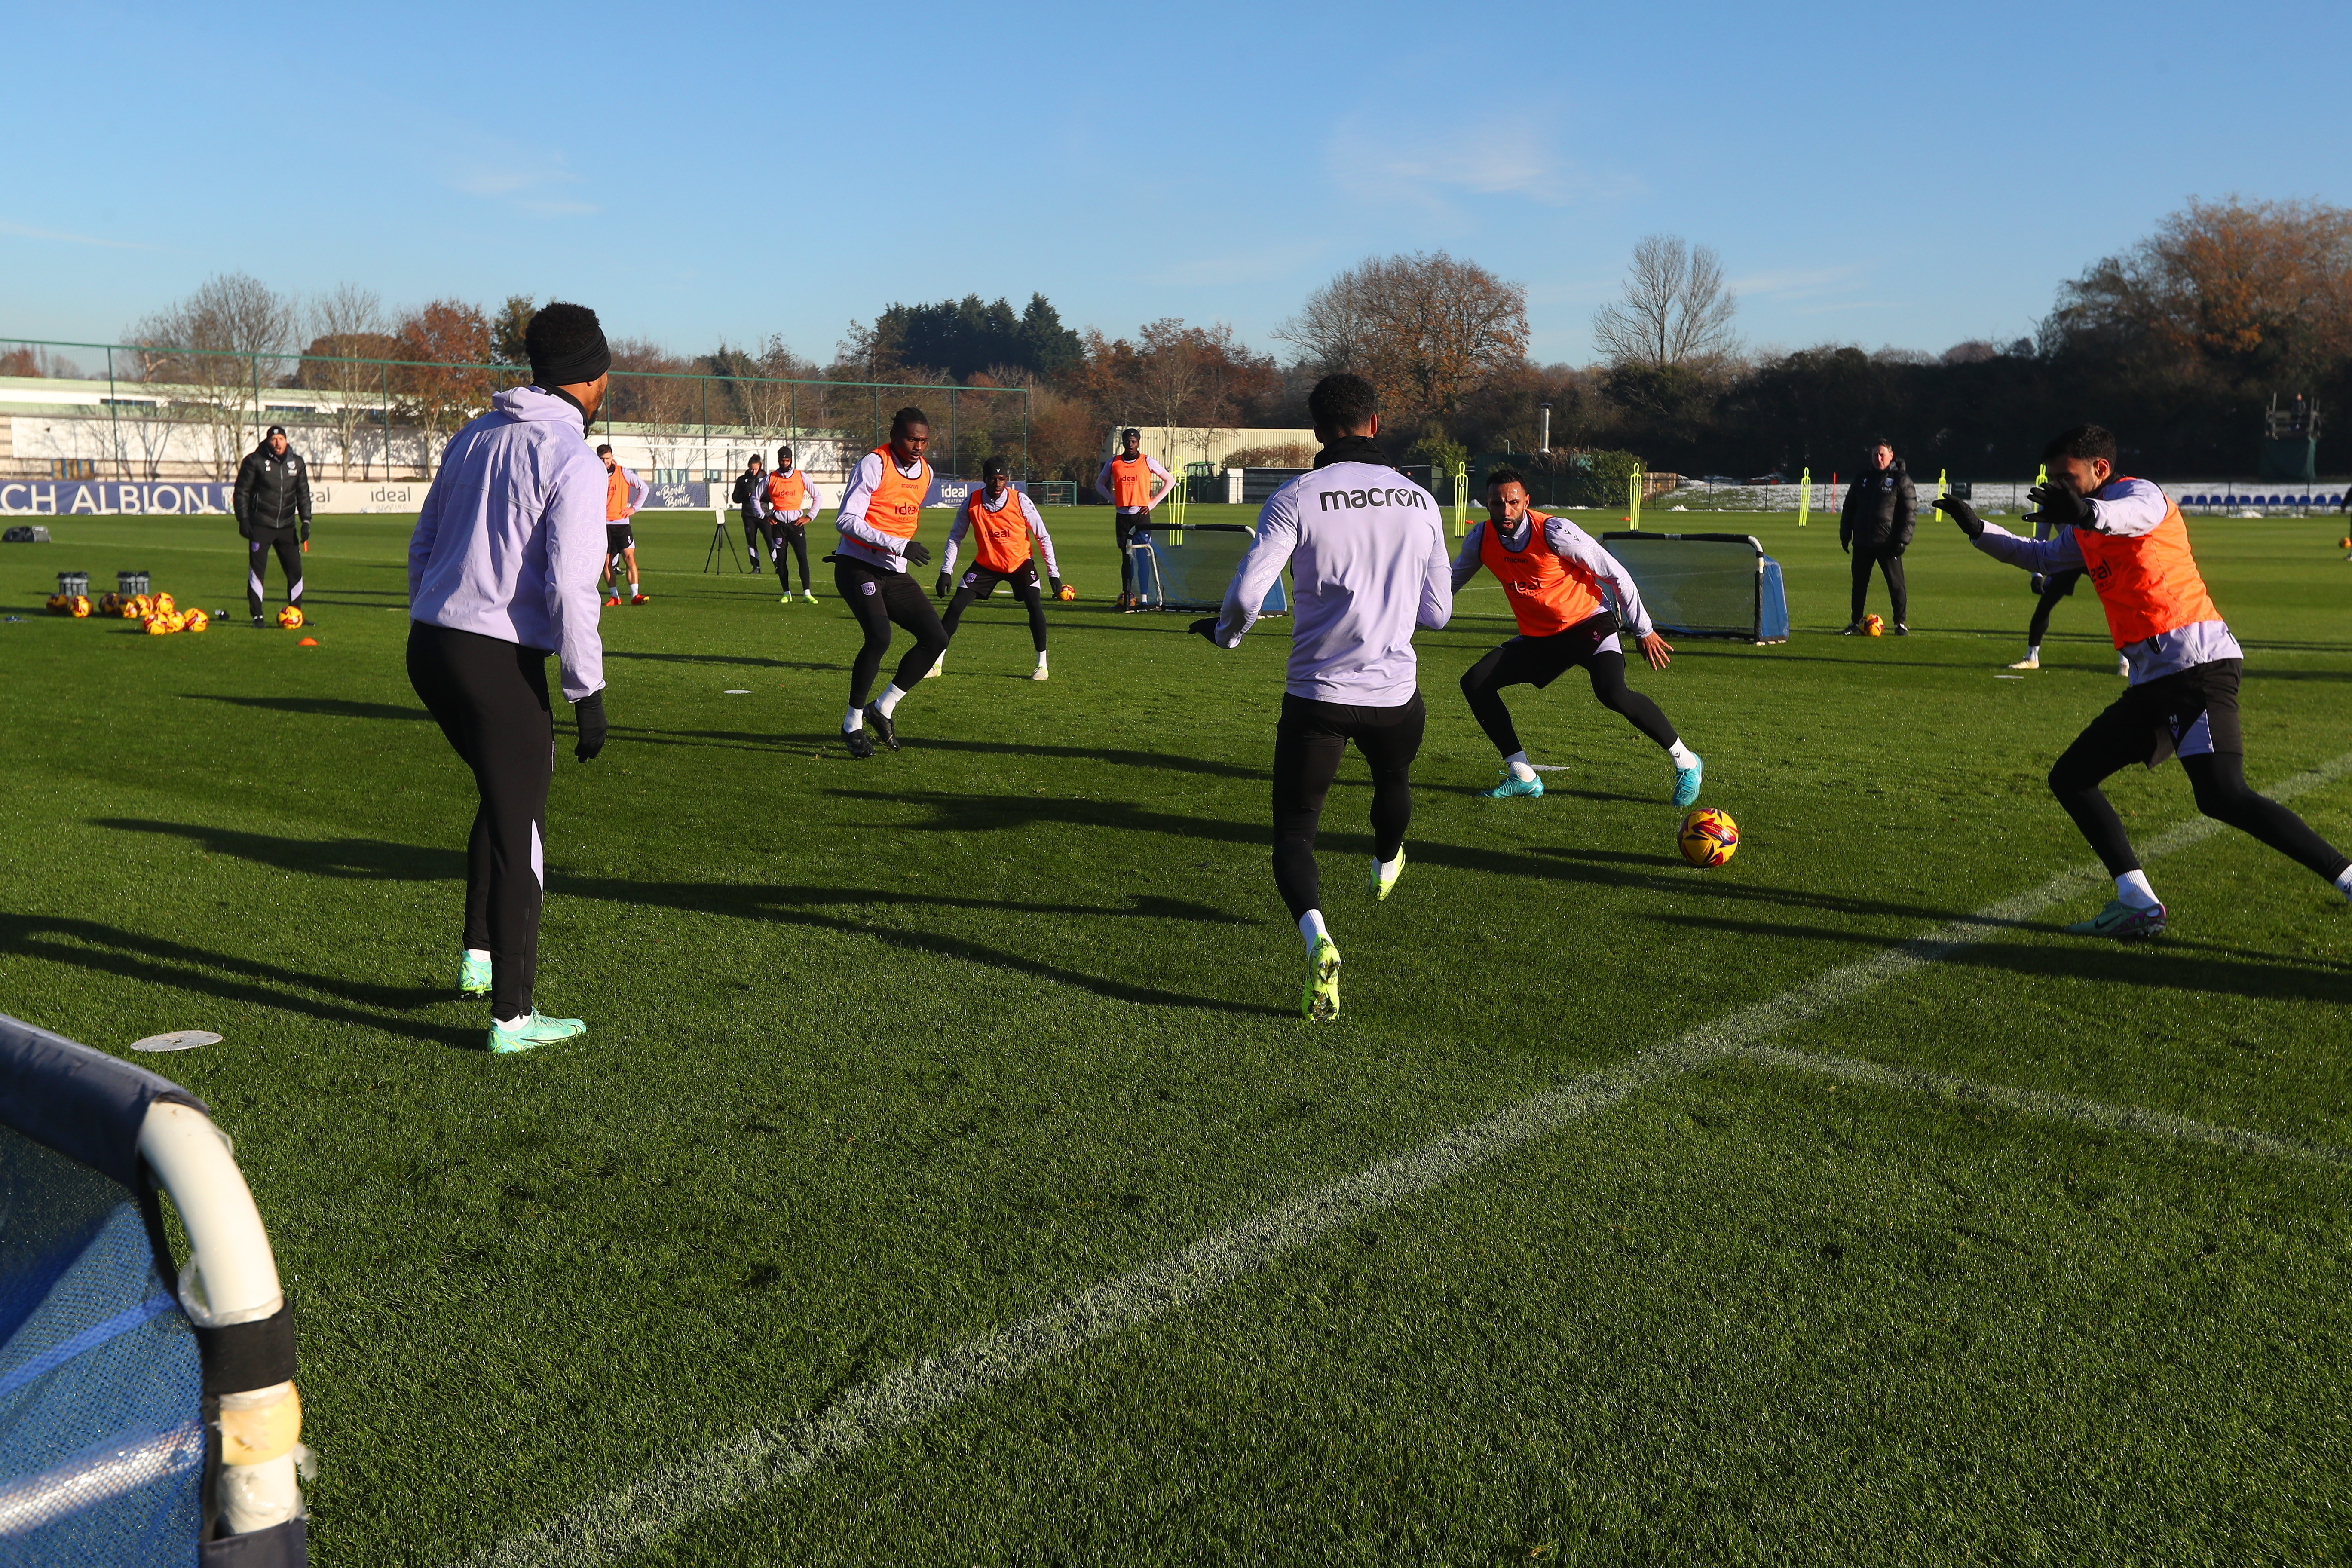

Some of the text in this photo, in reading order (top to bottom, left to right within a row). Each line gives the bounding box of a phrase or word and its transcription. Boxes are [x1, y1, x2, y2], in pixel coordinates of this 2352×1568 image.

[371, 486, 410, 502] ideal
[941, 484, 968, 498] ideal
[70, 484, 209, 515] ALBION
[1319, 487, 1427, 512] macron
[984, 528, 1010, 538] ideal
[2169, 714, 2177, 724] 24
